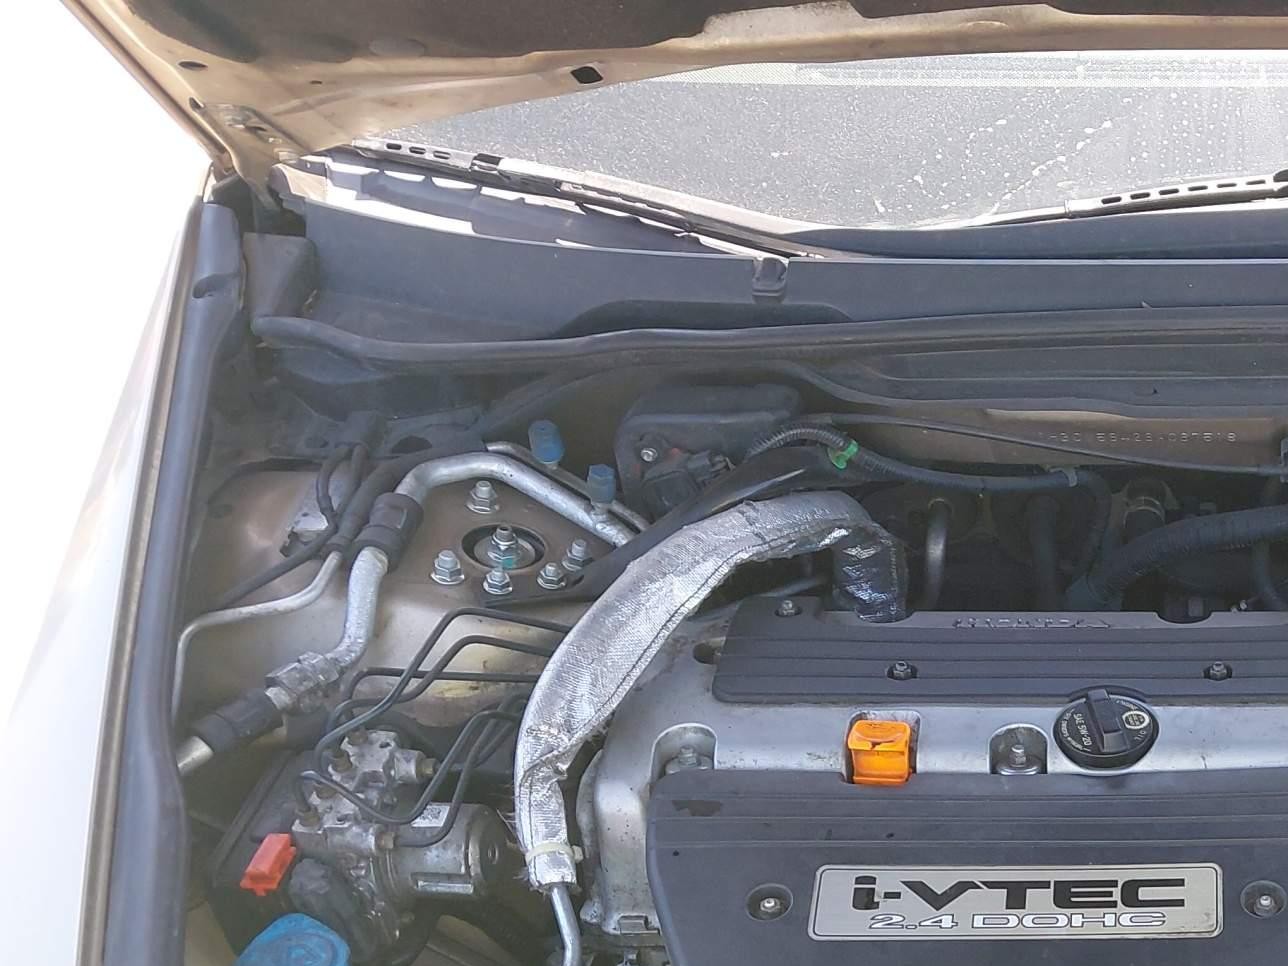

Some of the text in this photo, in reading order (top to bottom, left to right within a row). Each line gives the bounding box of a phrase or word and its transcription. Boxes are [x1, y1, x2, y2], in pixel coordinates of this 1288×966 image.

[852, 875, 1185, 911] i-VTEC
[868, 912, 1168, 930] 2.4 DOHC
